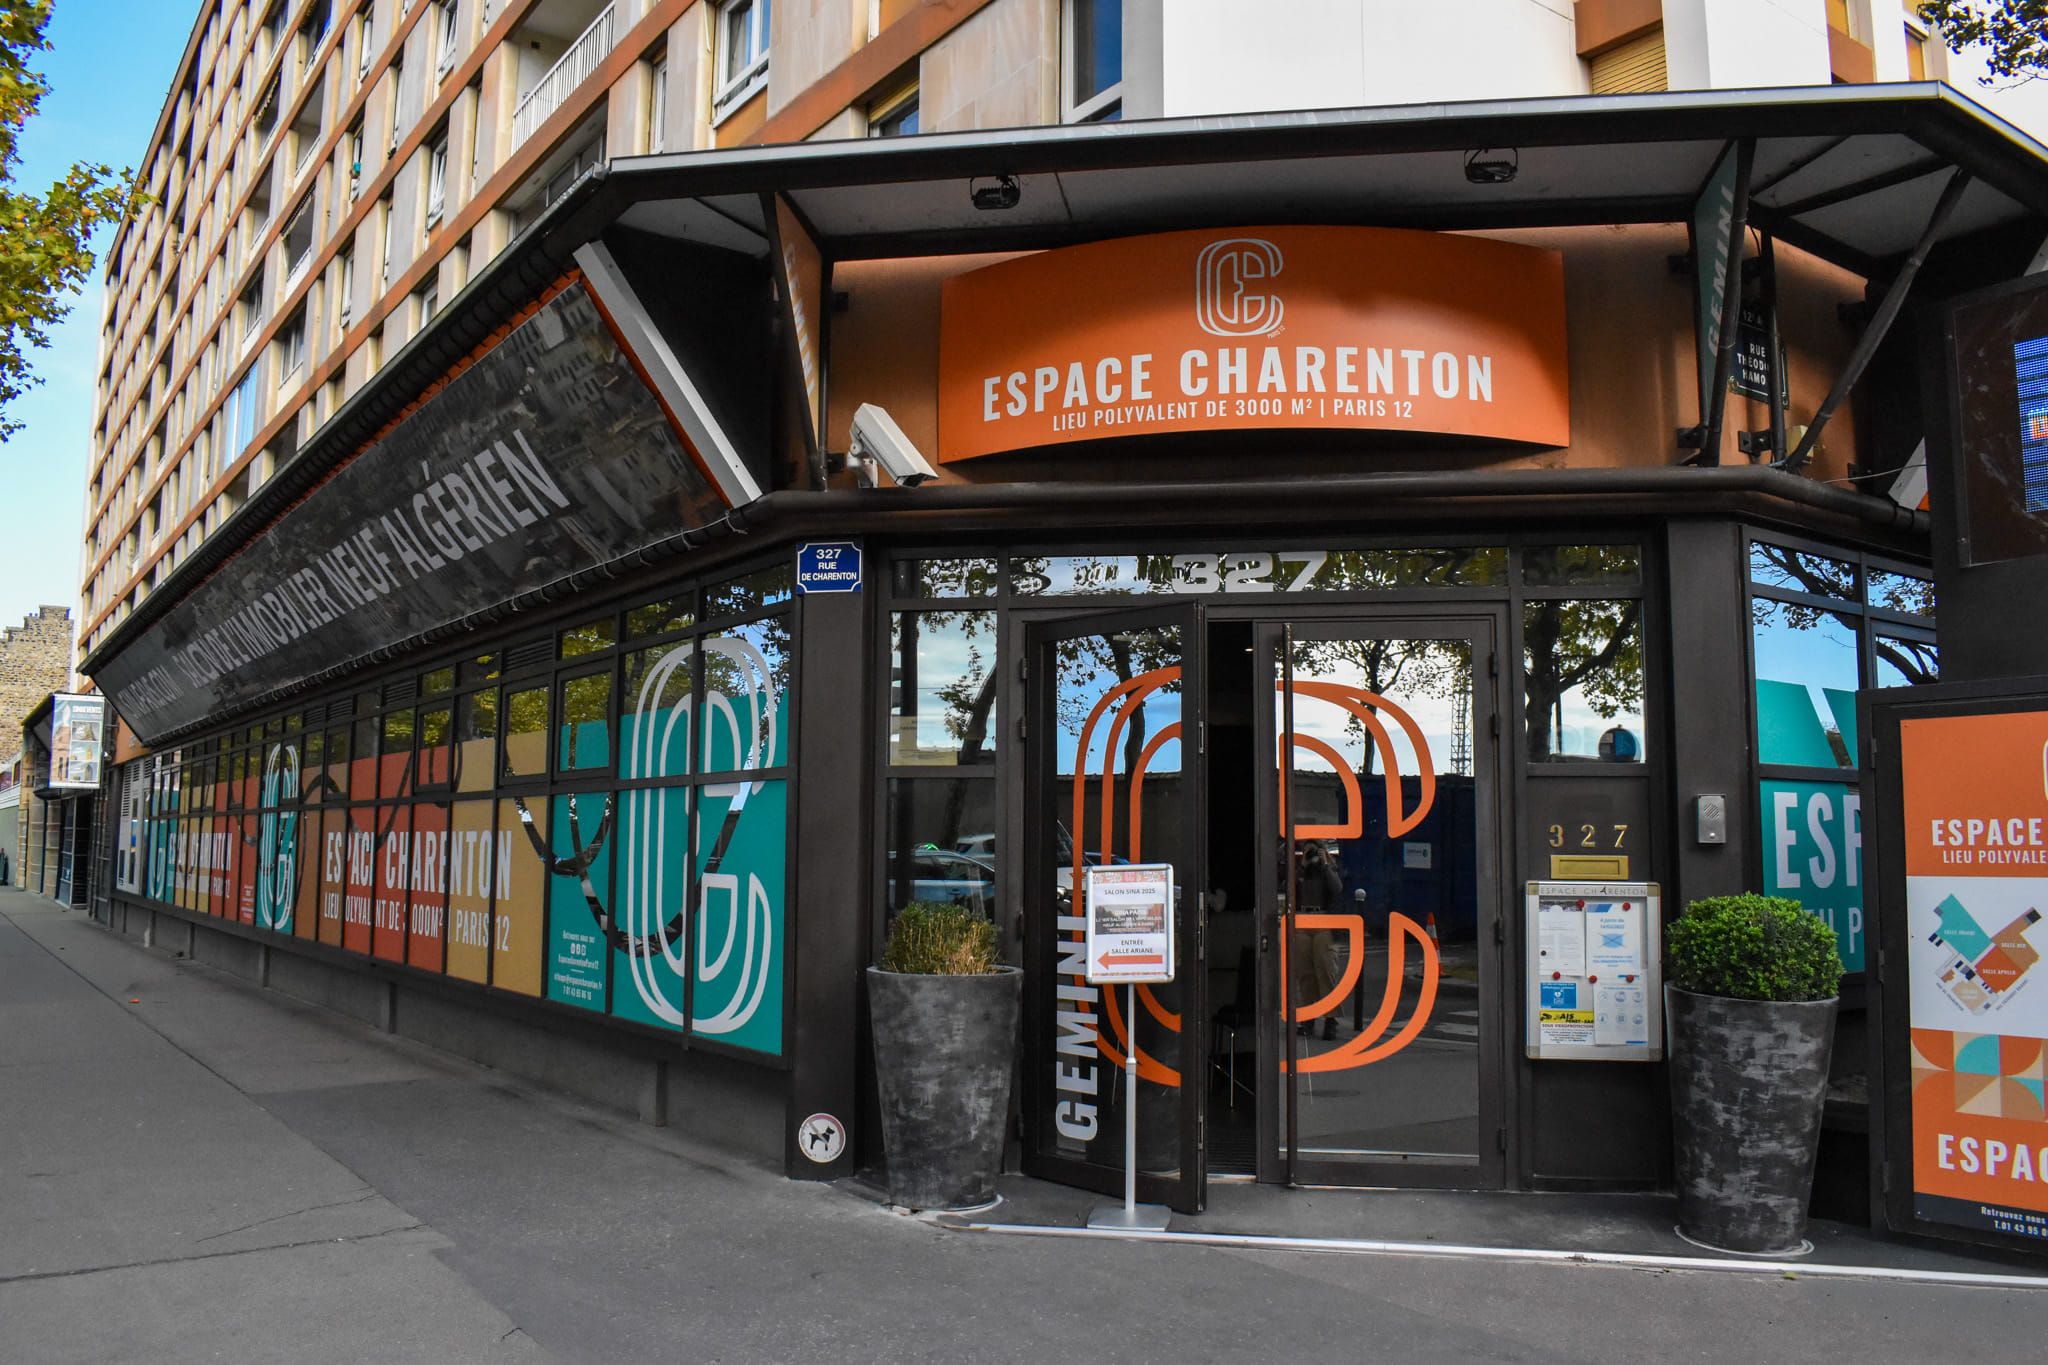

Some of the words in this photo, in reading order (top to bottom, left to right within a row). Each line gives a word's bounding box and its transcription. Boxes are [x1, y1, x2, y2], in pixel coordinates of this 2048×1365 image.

[1750, 343, 1766, 357] RUE
[983, 354, 1153, 422] ESPACE
[1180, 346, 1493, 402] CHARENTON
[1053, 411, 1087, 432] LIEU
[1094, 401, 1199, 427] POLYVALENT
[1206, 400, 1228, 417] DE
[1235, 398, 1283, 416] 3000
[1333, 399, 1387, 417] PARIS
[1394, 401, 1413, 418] 12
[172, 634, 226, 688] SALON
[219, 567, 346, 663] L'IMMOBILIER
[317, 527, 401, 609] NEUF
[380, 429, 570, 580] ALGÉRIEN
[816, 549, 842, 559] 327
[818, 562, 837, 570] RUE
[1171, 551, 1328, 593] 327
[801, 573, 812, 581] DE
[812, 572, 857, 581] CHARENTON
[1932, 818, 2044, 846] ESPACE
[1943, 850, 1973, 863] LIEU
[1979, 850, 2048, 864] POLYVALE
[1541, 887, 1577, 895] ESPACE
[1583, 886, 1647, 895] CHARENTON
[324, 892, 340, 920] LIEU
[388, 900, 400, 931] DE
[456, 909, 489, 949] PARIS
[496, 915, 511, 951] 12
[1056, 916, 1099, 1141] GEMINI
[1981, 1206, 2023, 1221] Retrouvez
[2026, 1215, 2047, 1224] nous
[2014, 1223, 2025, 1233] 43
[2028, 1226, 2039, 1235] 95
